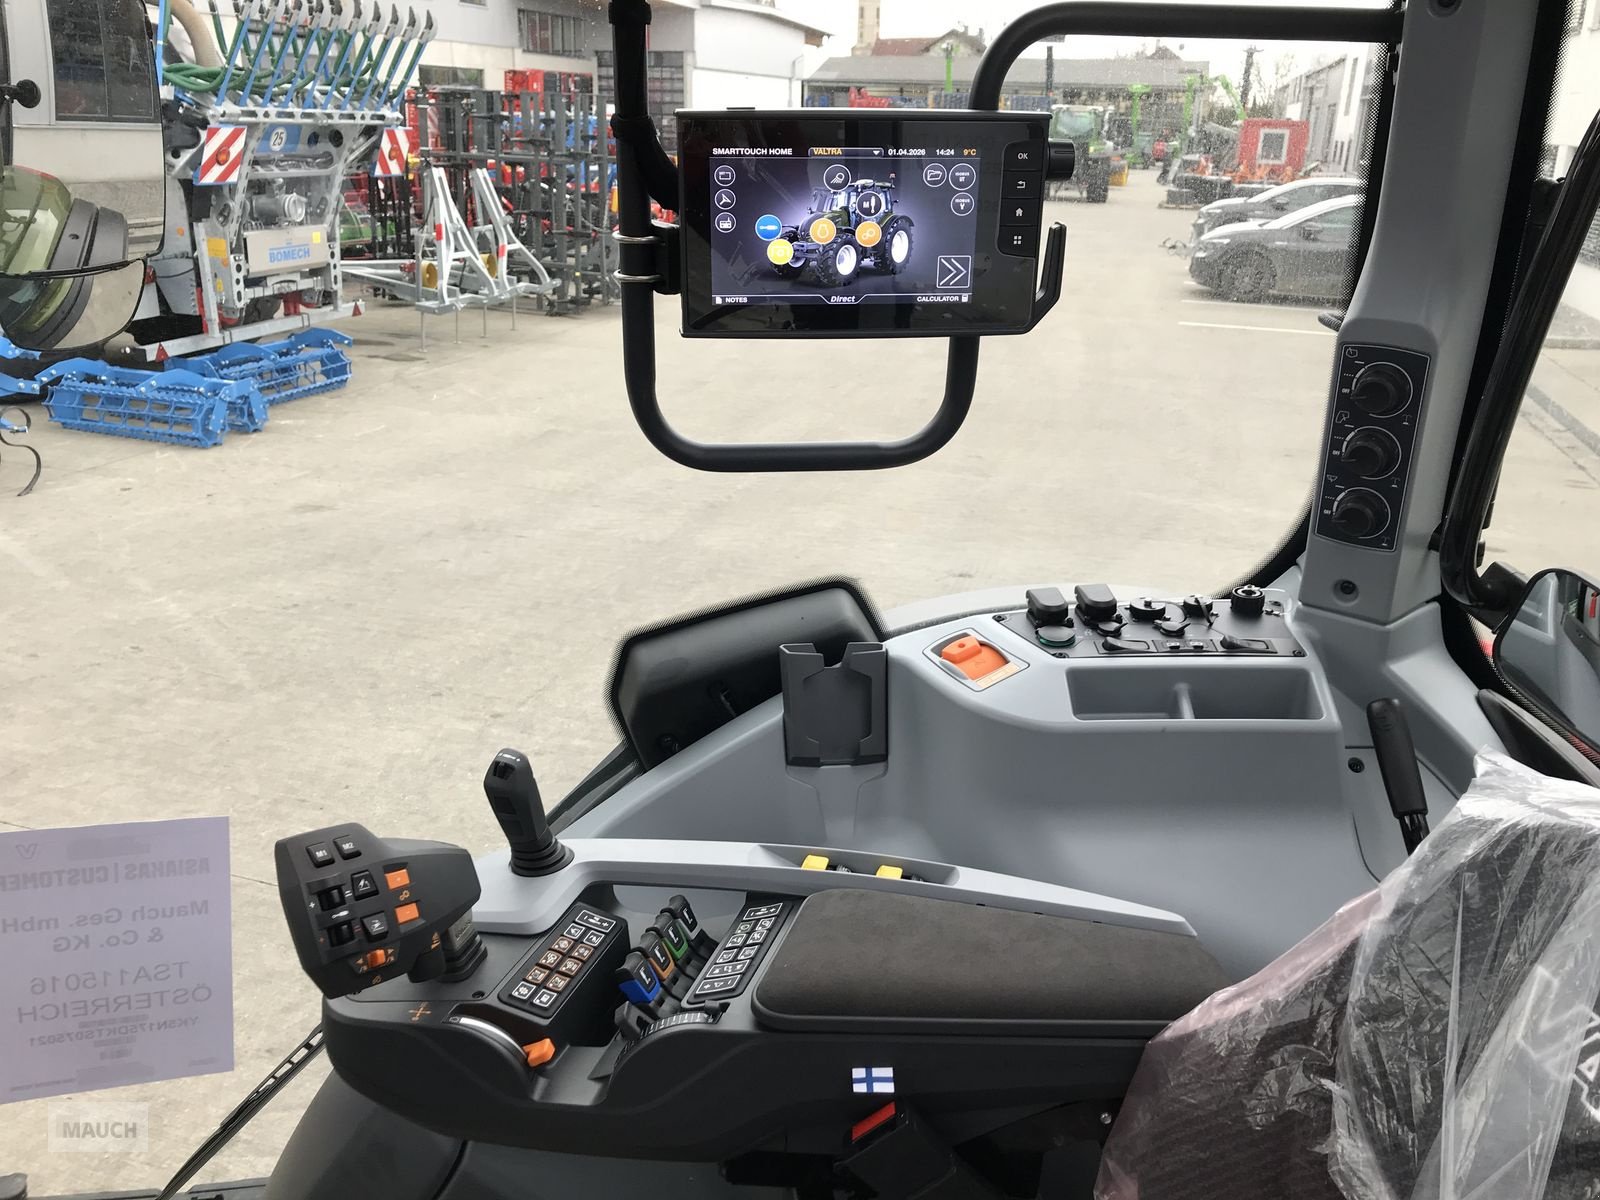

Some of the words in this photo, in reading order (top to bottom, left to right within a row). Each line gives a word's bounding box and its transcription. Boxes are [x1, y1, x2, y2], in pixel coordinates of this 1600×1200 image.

[272, 132, 284, 146] 25
[887, 148, 926, 156] 01.04.2026
[935, 148, 955, 156] 14:24
[1017, 152, 1029, 160] OK
[269, 248, 310, 263] BOMECH
[342, 842, 354, 850] M2
